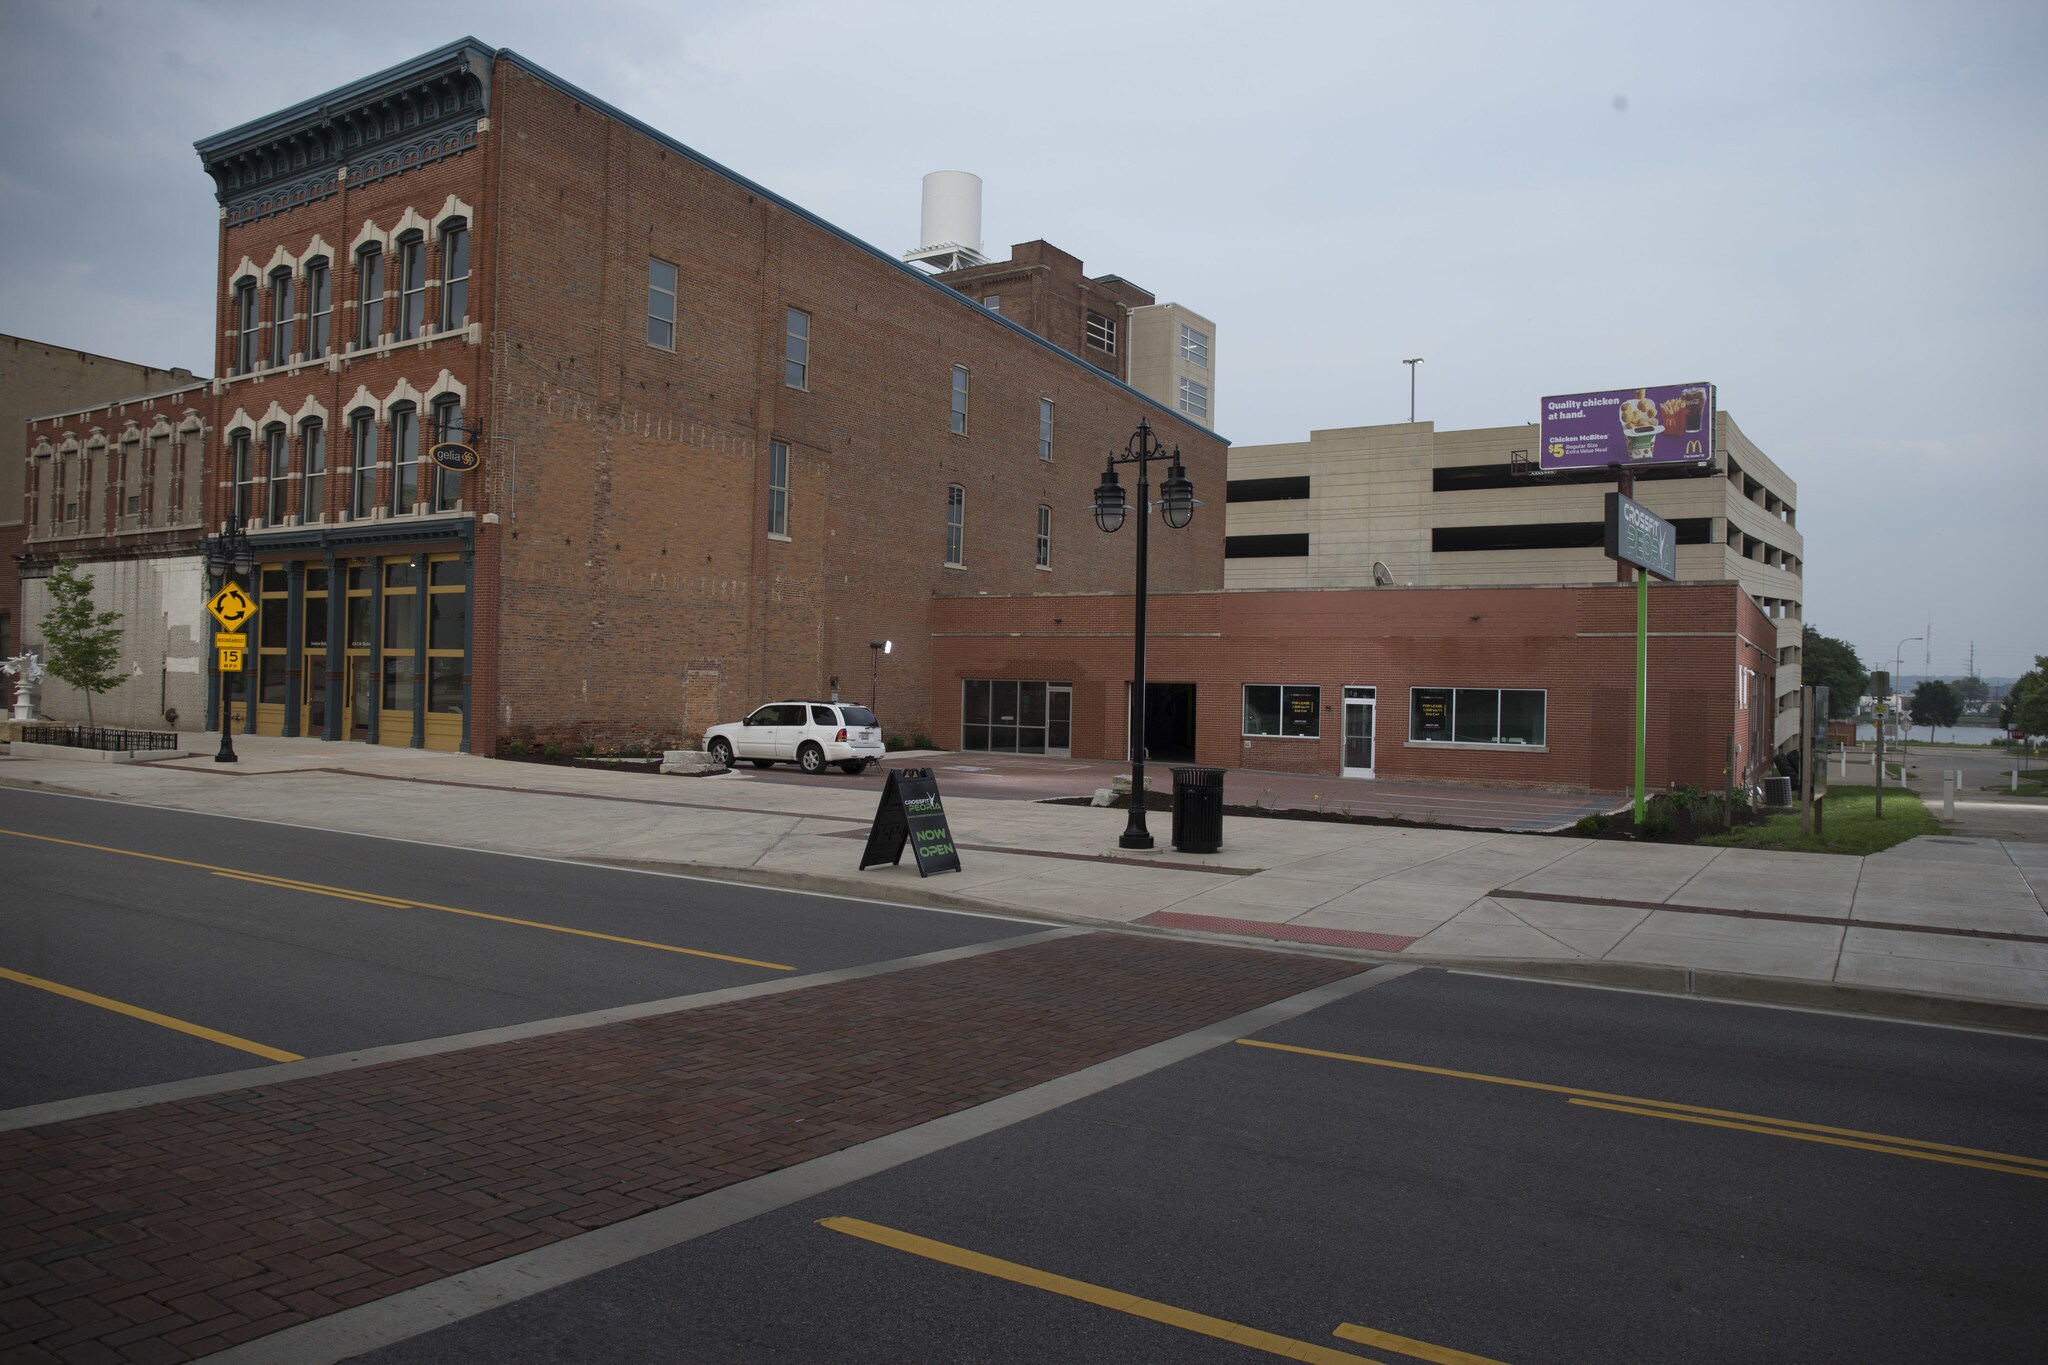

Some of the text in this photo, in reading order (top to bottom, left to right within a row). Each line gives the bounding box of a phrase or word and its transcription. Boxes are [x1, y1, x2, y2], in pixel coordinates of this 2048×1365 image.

[1548, 397, 1620, 410] Quality chicken
[1548, 410, 1586, 421] at hand.
[1549, 435, 1578, 443] Chicken
[437, 450, 460, 461] gelia
[1548, 443, 1565, 458] $5
[1624, 503, 1659, 536] CROSSFIT
[224, 651, 238, 662] 15
[909, 803, 941, 812] PEORIA
[916, 828, 946, 842] NOW
[920, 843, 954, 857] OPEN
